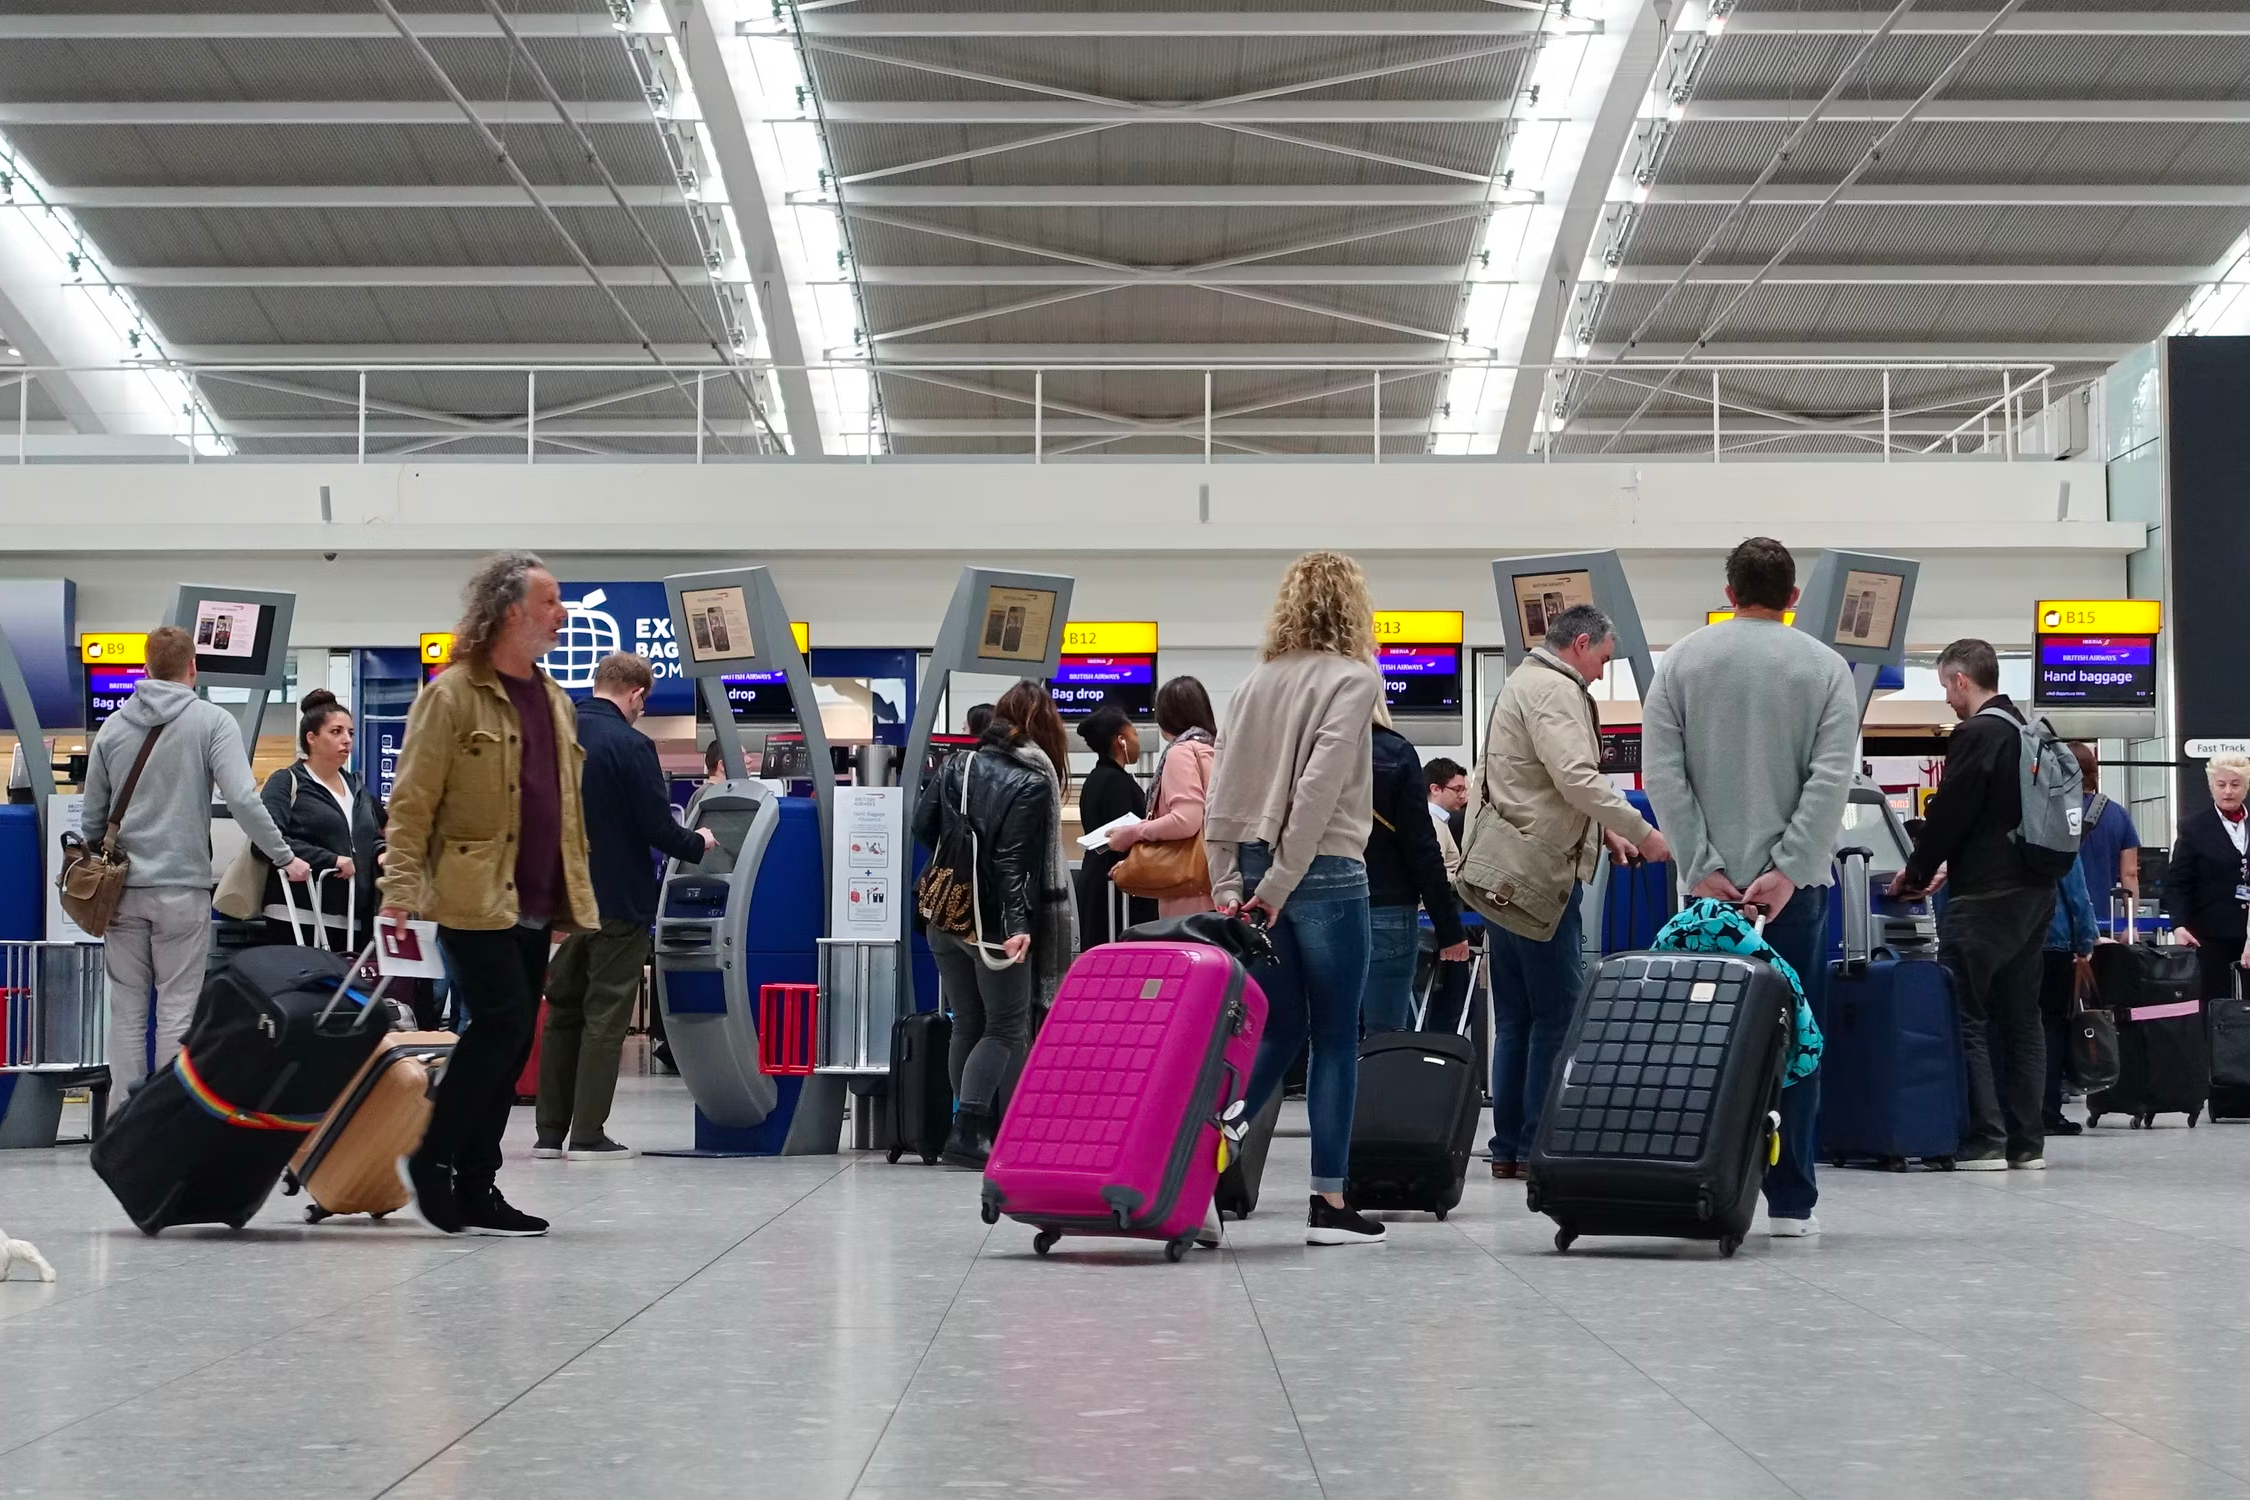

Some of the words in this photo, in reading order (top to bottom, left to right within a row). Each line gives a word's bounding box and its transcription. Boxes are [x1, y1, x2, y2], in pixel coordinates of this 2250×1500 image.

[2066, 611, 2096, 624] B15
[1373, 621, 1401, 634] B13
[1069, 632, 1097, 645] B12
[107, 642, 125, 655] B9
[651, 662, 684, 679] OM
[1396, 663, 1424, 671] AIRWAYS
[746, 672, 772, 681] AIRWAYS
[2044, 670, 2076, 682] Hand
[2079, 670, 2133, 685] baggage
[728, 688, 756, 702] drop
[1051, 688, 1074, 702] Bag
[1076, 687, 1104, 702] drop
[92, 697, 115, 711] Bag
[2197, 743, 2217, 753] Fast
[2219, 743, 2246, 753] Track
